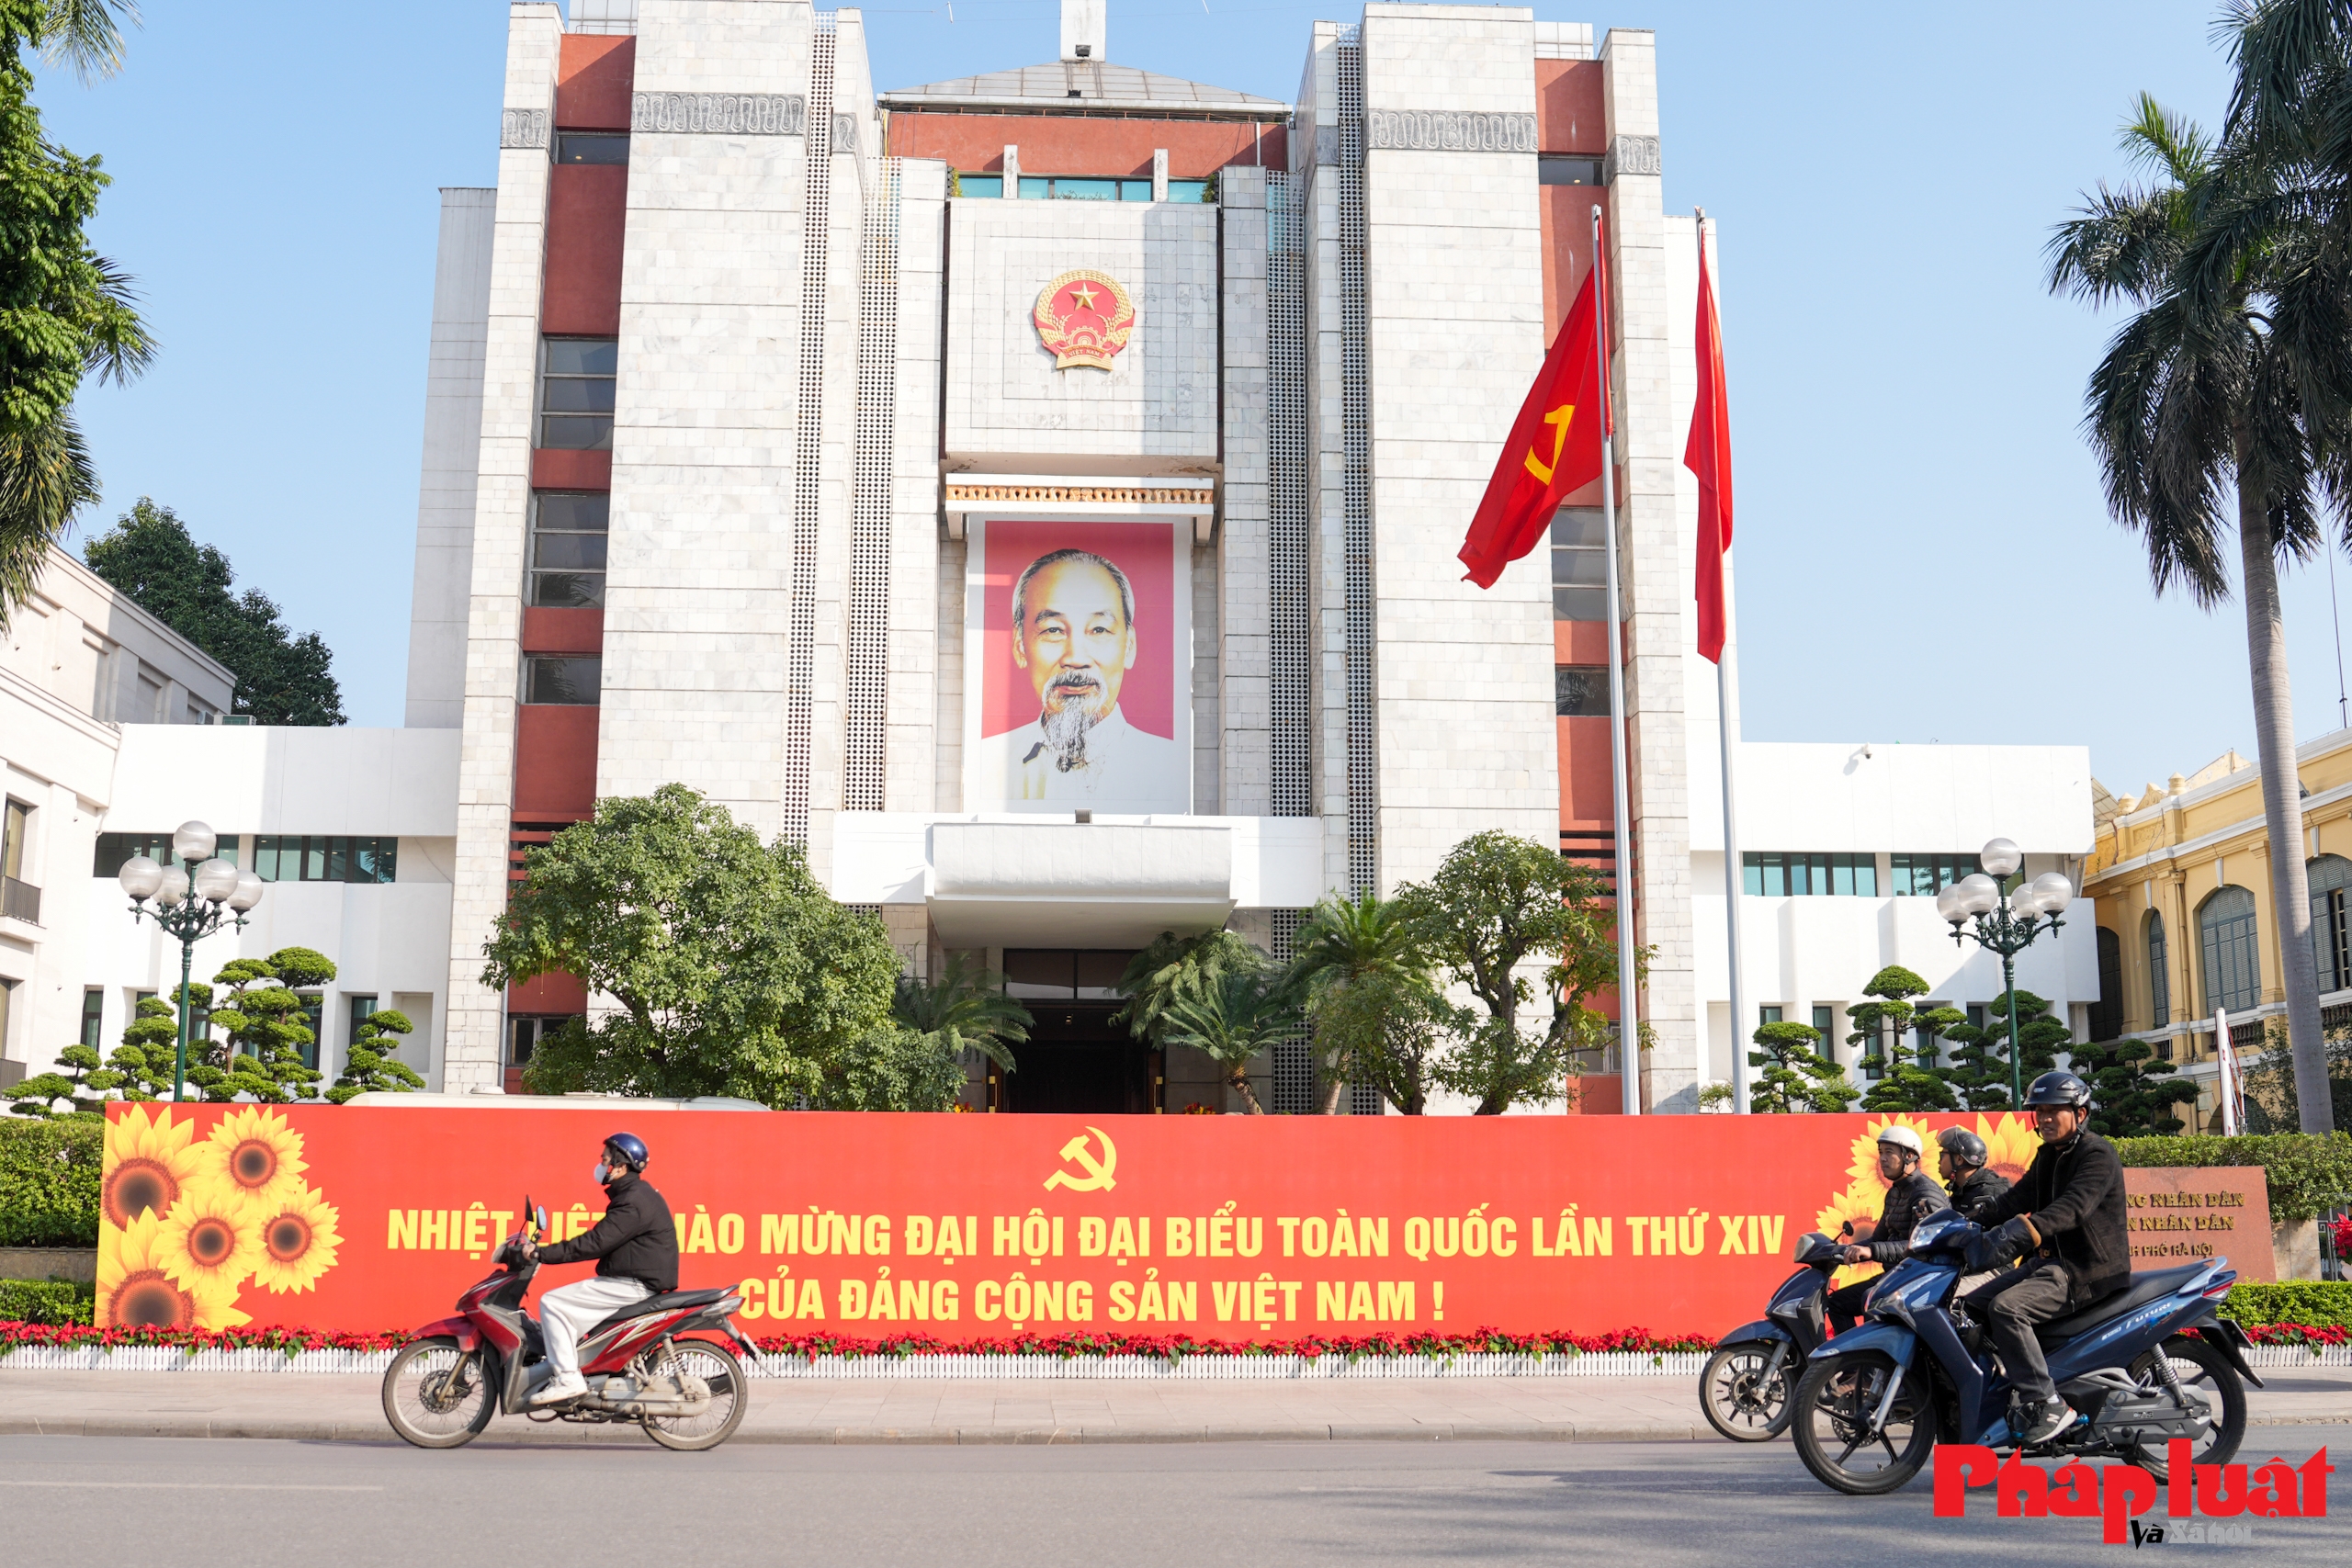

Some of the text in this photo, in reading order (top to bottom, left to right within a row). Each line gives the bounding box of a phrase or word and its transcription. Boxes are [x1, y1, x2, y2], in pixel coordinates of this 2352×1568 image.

[2151, 1190, 2203, 1208] NHÂN
[2206, 1190, 2245, 1207] DÂN
[388, 1201, 514, 1260] NHIỆT
[674, 1204, 745, 1255] ÀO
[761, 1205, 891, 1255] MỪNG
[905, 1215, 978, 1266] ĐẠI
[993, 1207, 1064, 1266] HỘI
[1079, 1216, 1150, 1266] ĐẠI
[1166, 1200, 1263, 1258] BIỂU
[1277, 1208, 1389, 1258] TOÀN
[1405, 1202, 1517, 1262] QUỐC
[1532, 1202, 1613, 1257] LẦN
[1626, 1207, 1710, 1256] THỨ
[1718, 1214, 1785, 1255] XIV
[2141, 1214, 2193, 1232] NHÂN
[2196, 1213, 2234, 1231] DÂN
[739, 1265, 826, 1320] CỦA
[839, 1266, 959, 1321] ĐẢNG
[975, 1271, 1093, 1330] CỘNG
[1108, 1267, 1197, 1322] SẢN
[1211, 1272, 1303, 1331] VIỆT
[1316, 1280, 1416, 1321] NAM
